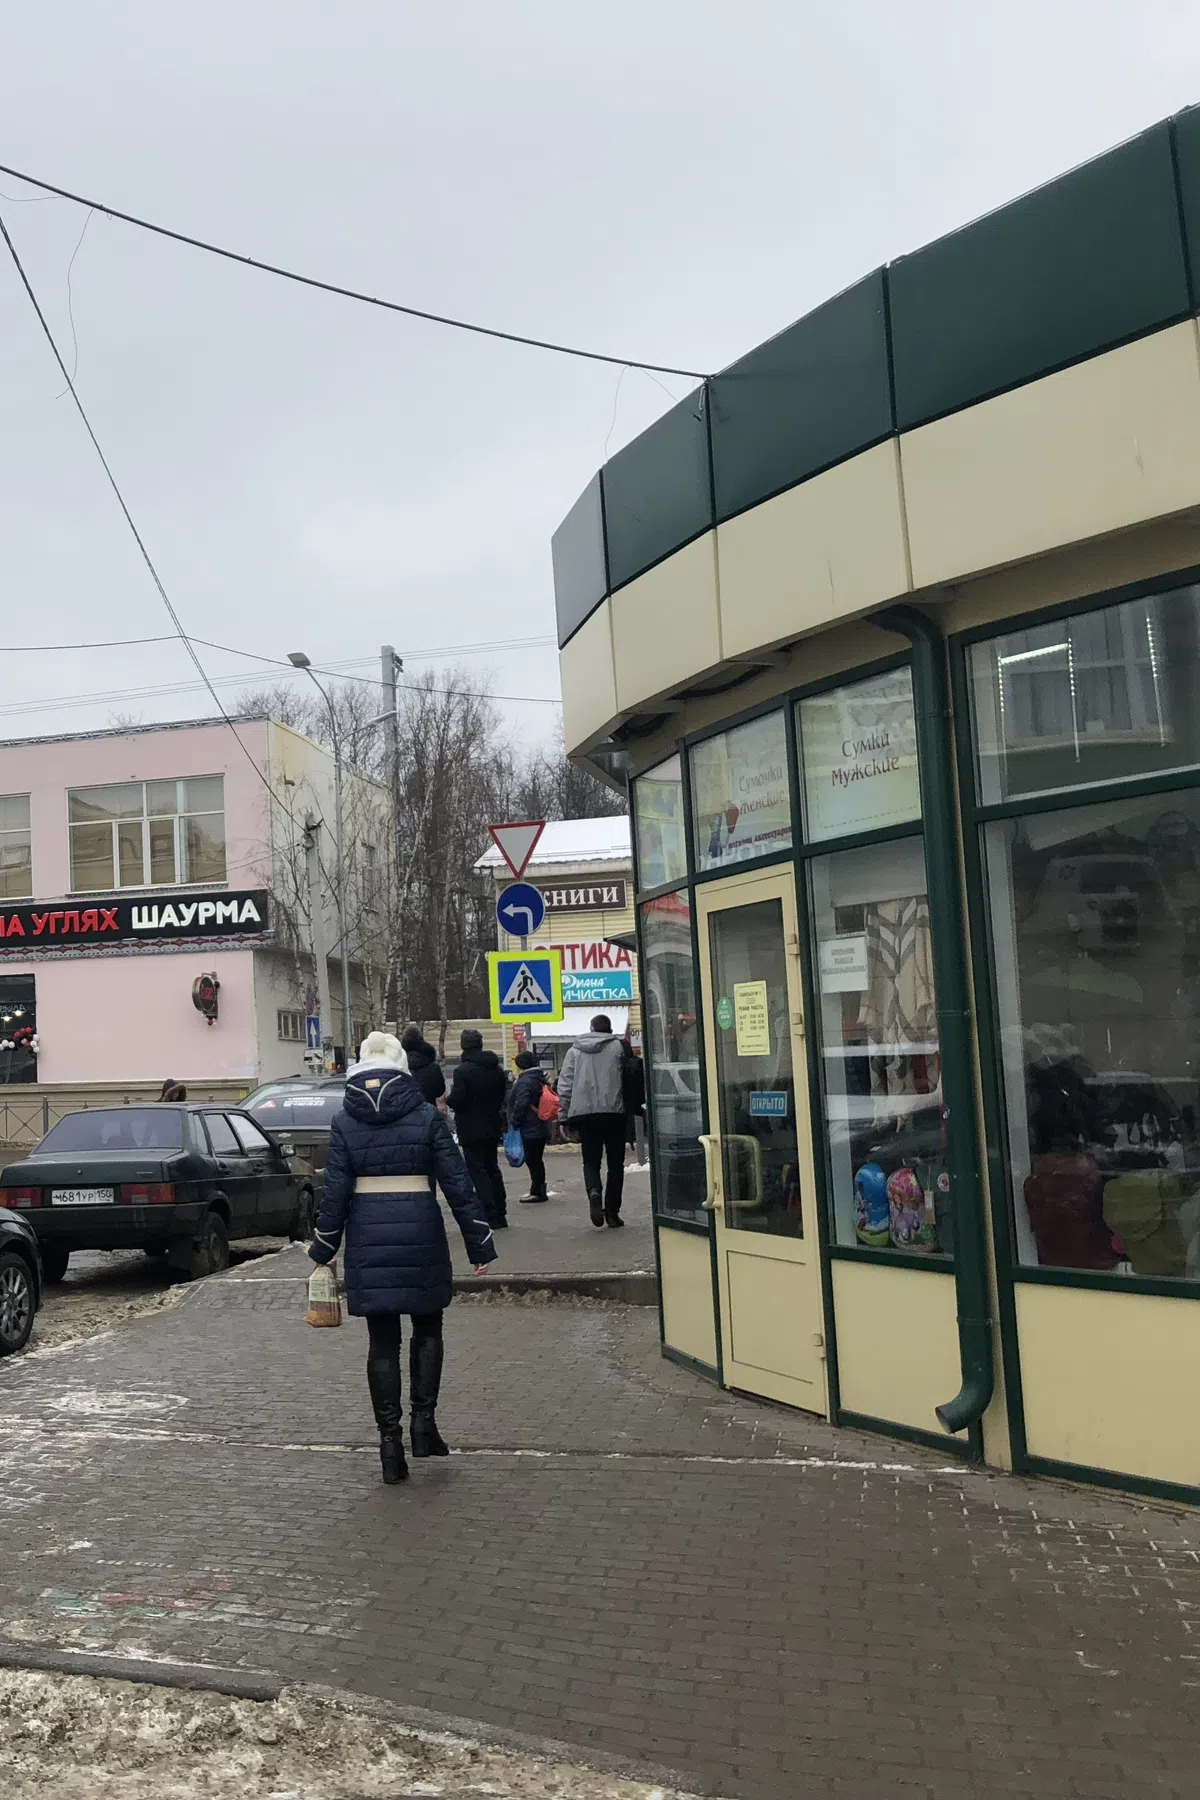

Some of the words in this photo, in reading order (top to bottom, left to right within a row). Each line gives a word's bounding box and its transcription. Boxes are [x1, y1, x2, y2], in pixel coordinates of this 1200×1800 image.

[842, 732, 890, 760] Сумки
[831, 755, 900, 788] Мужские
[32, 907, 120, 935] УГЛЯХ
[131, 898, 261, 930] ШАУРМА
[534, 942, 632, 971] ПТИКА
[752, 1097, 784, 1110] ОТКРЫТО
[97, 1189, 111, 1198] 150
